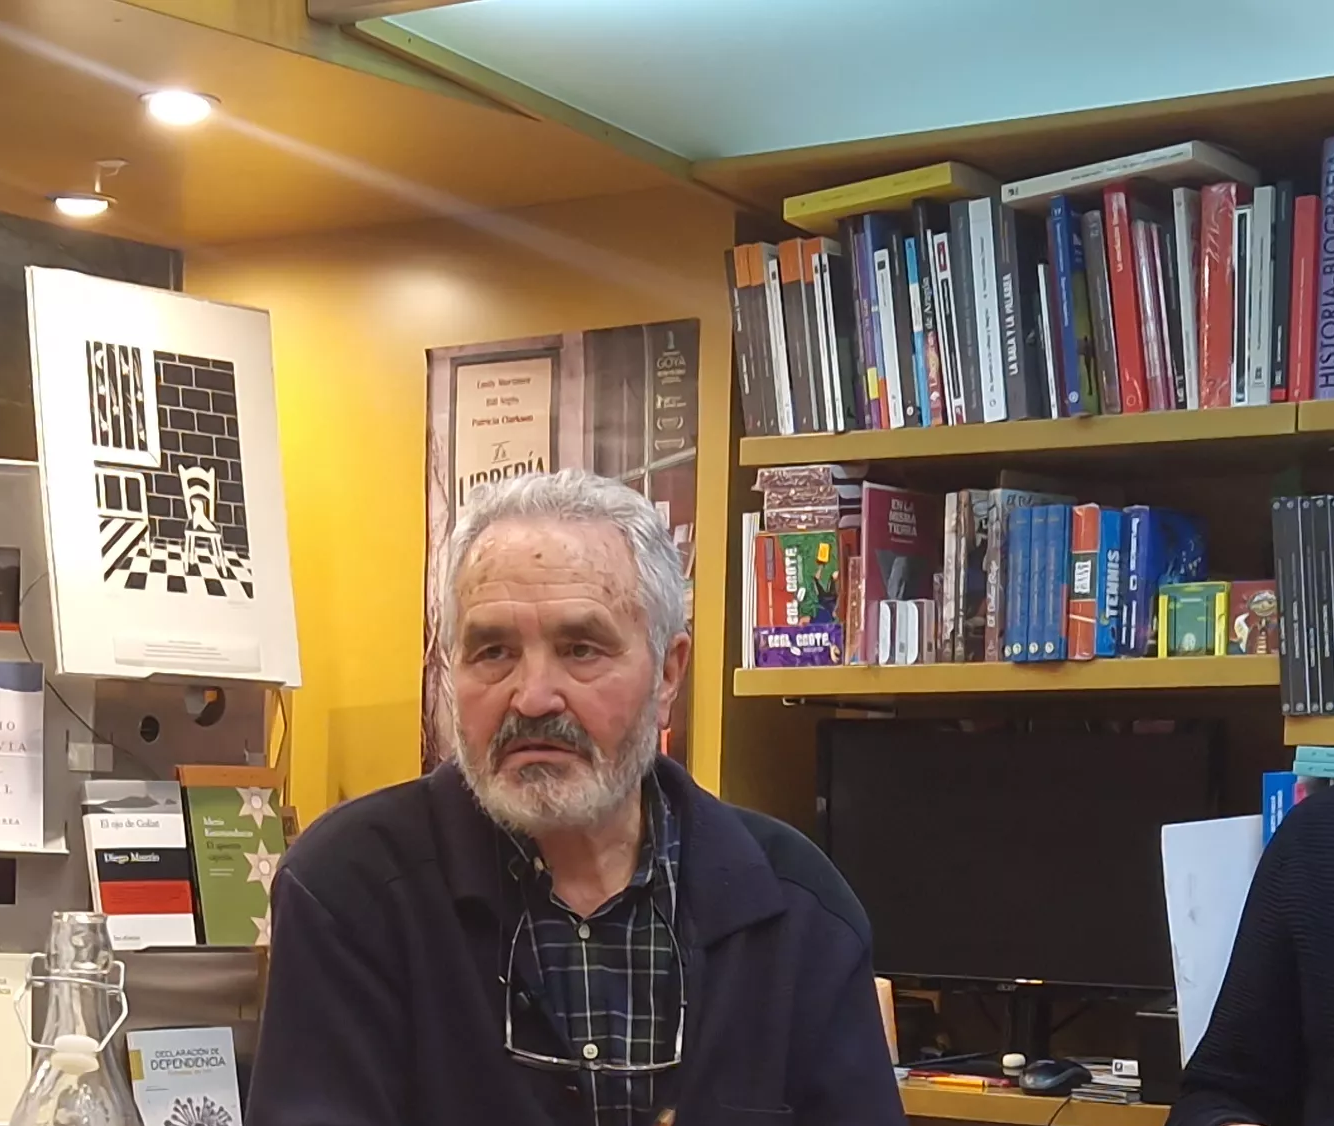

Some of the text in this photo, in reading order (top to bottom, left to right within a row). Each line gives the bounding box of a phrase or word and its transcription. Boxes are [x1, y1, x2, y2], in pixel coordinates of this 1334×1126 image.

[1001, 273, 1014, 314] PALABRA
[1006, 338, 1018, 360] BALA
[471, 416, 499, 428] Patricia
[1105, 549, 1120, 619] TENNIS
[150, 1056, 227, 1071] DEPENDENCIA
